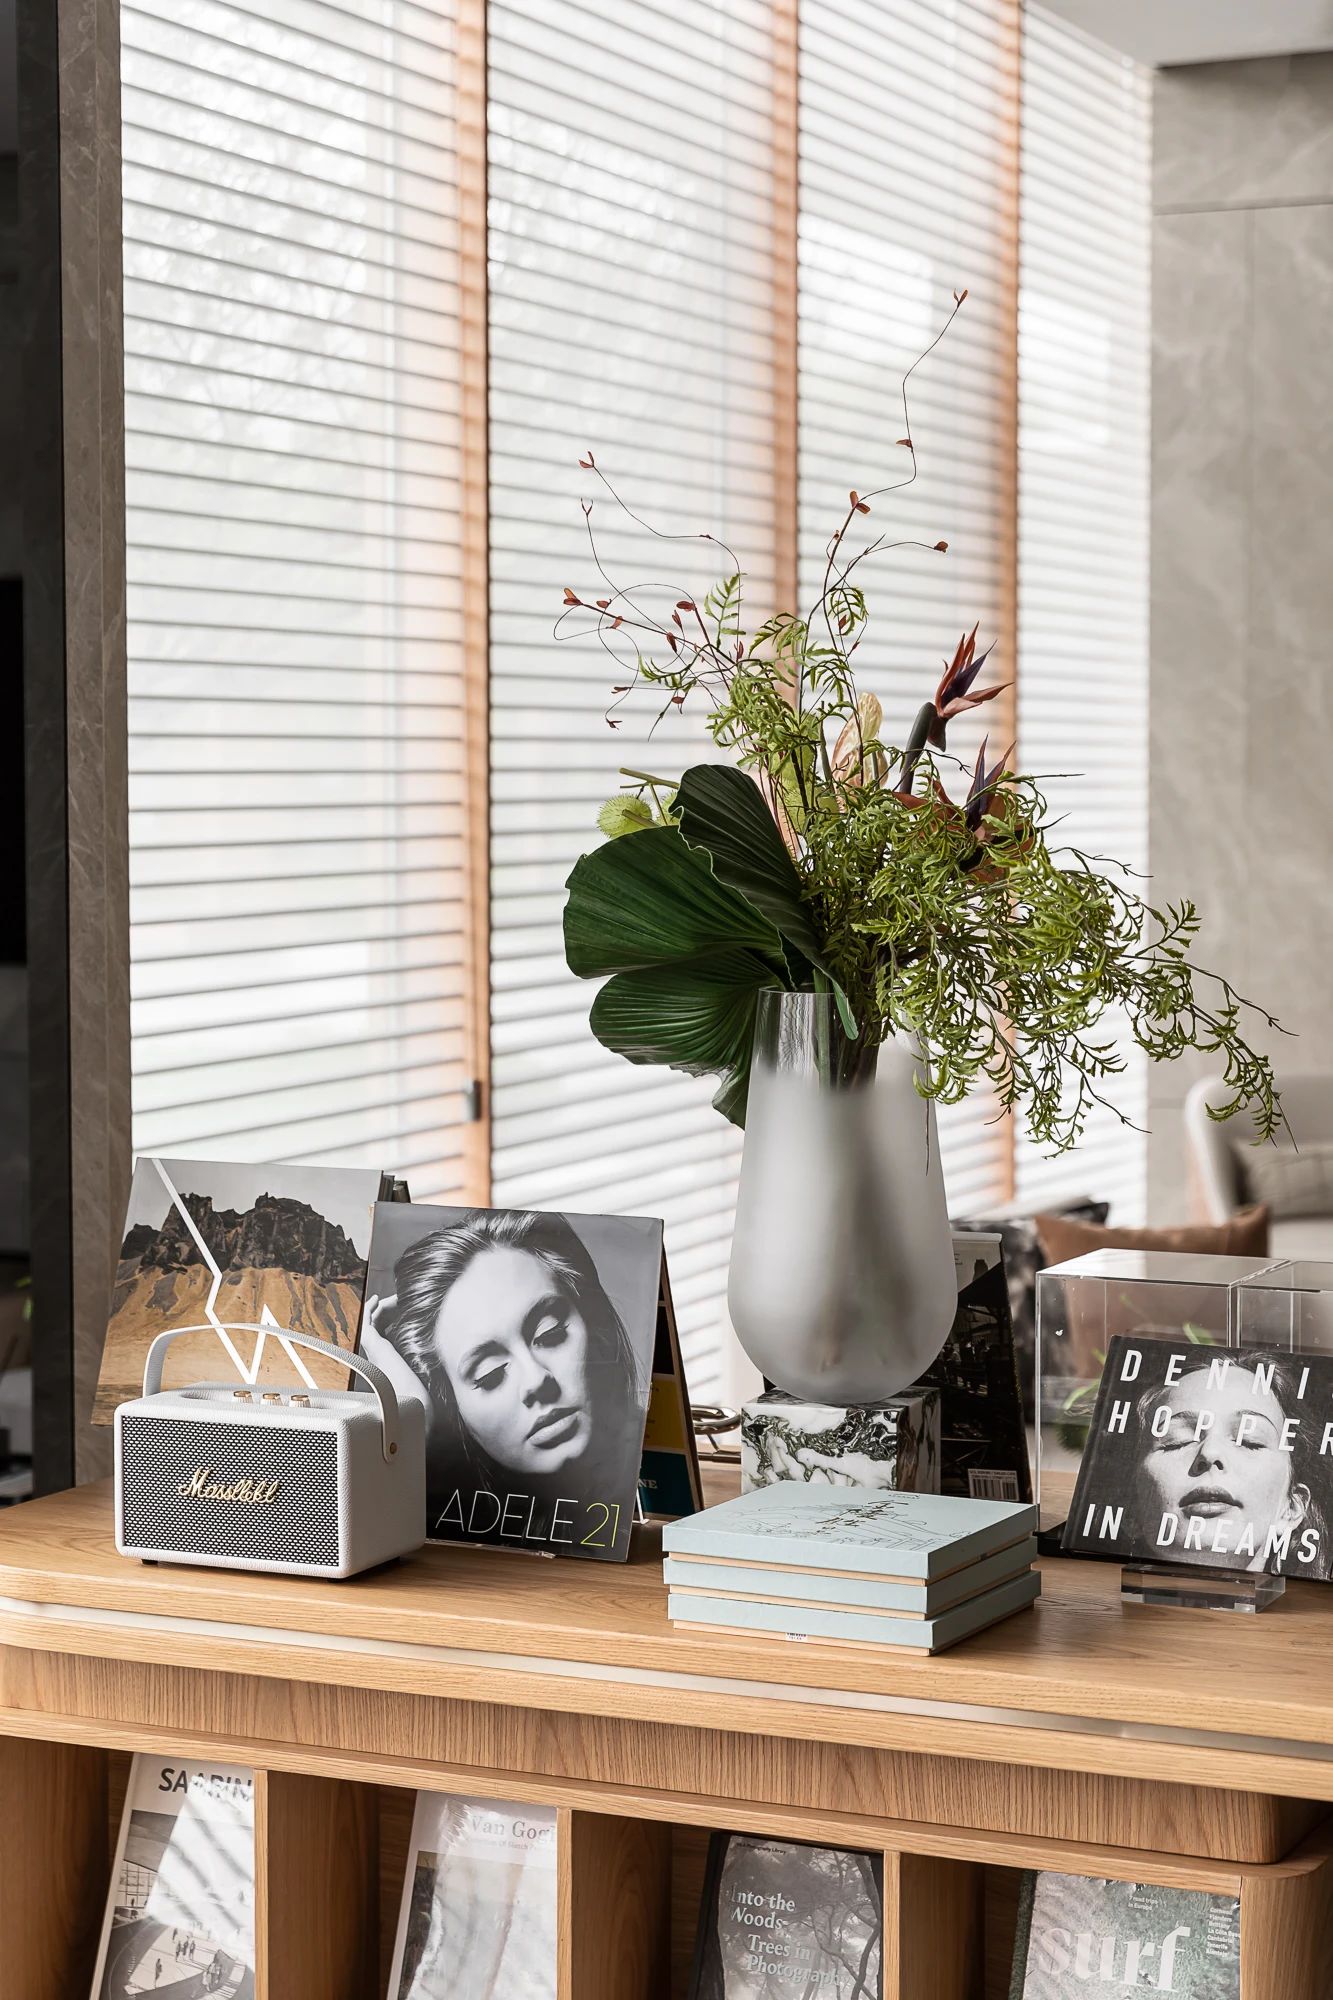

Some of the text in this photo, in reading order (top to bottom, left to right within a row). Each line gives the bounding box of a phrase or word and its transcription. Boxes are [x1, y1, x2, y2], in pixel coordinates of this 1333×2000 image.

[1119, 1349, 1333, 1400] DENNI
[435, 1488, 620, 1548] ADELE 21
[1082, 1503, 1320, 1563] IN DREAMS
[471, 1816, 505, 1836] Van
[731, 1885, 796, 1912] Into the
[748, 1934, 811, 1961] Trees in
